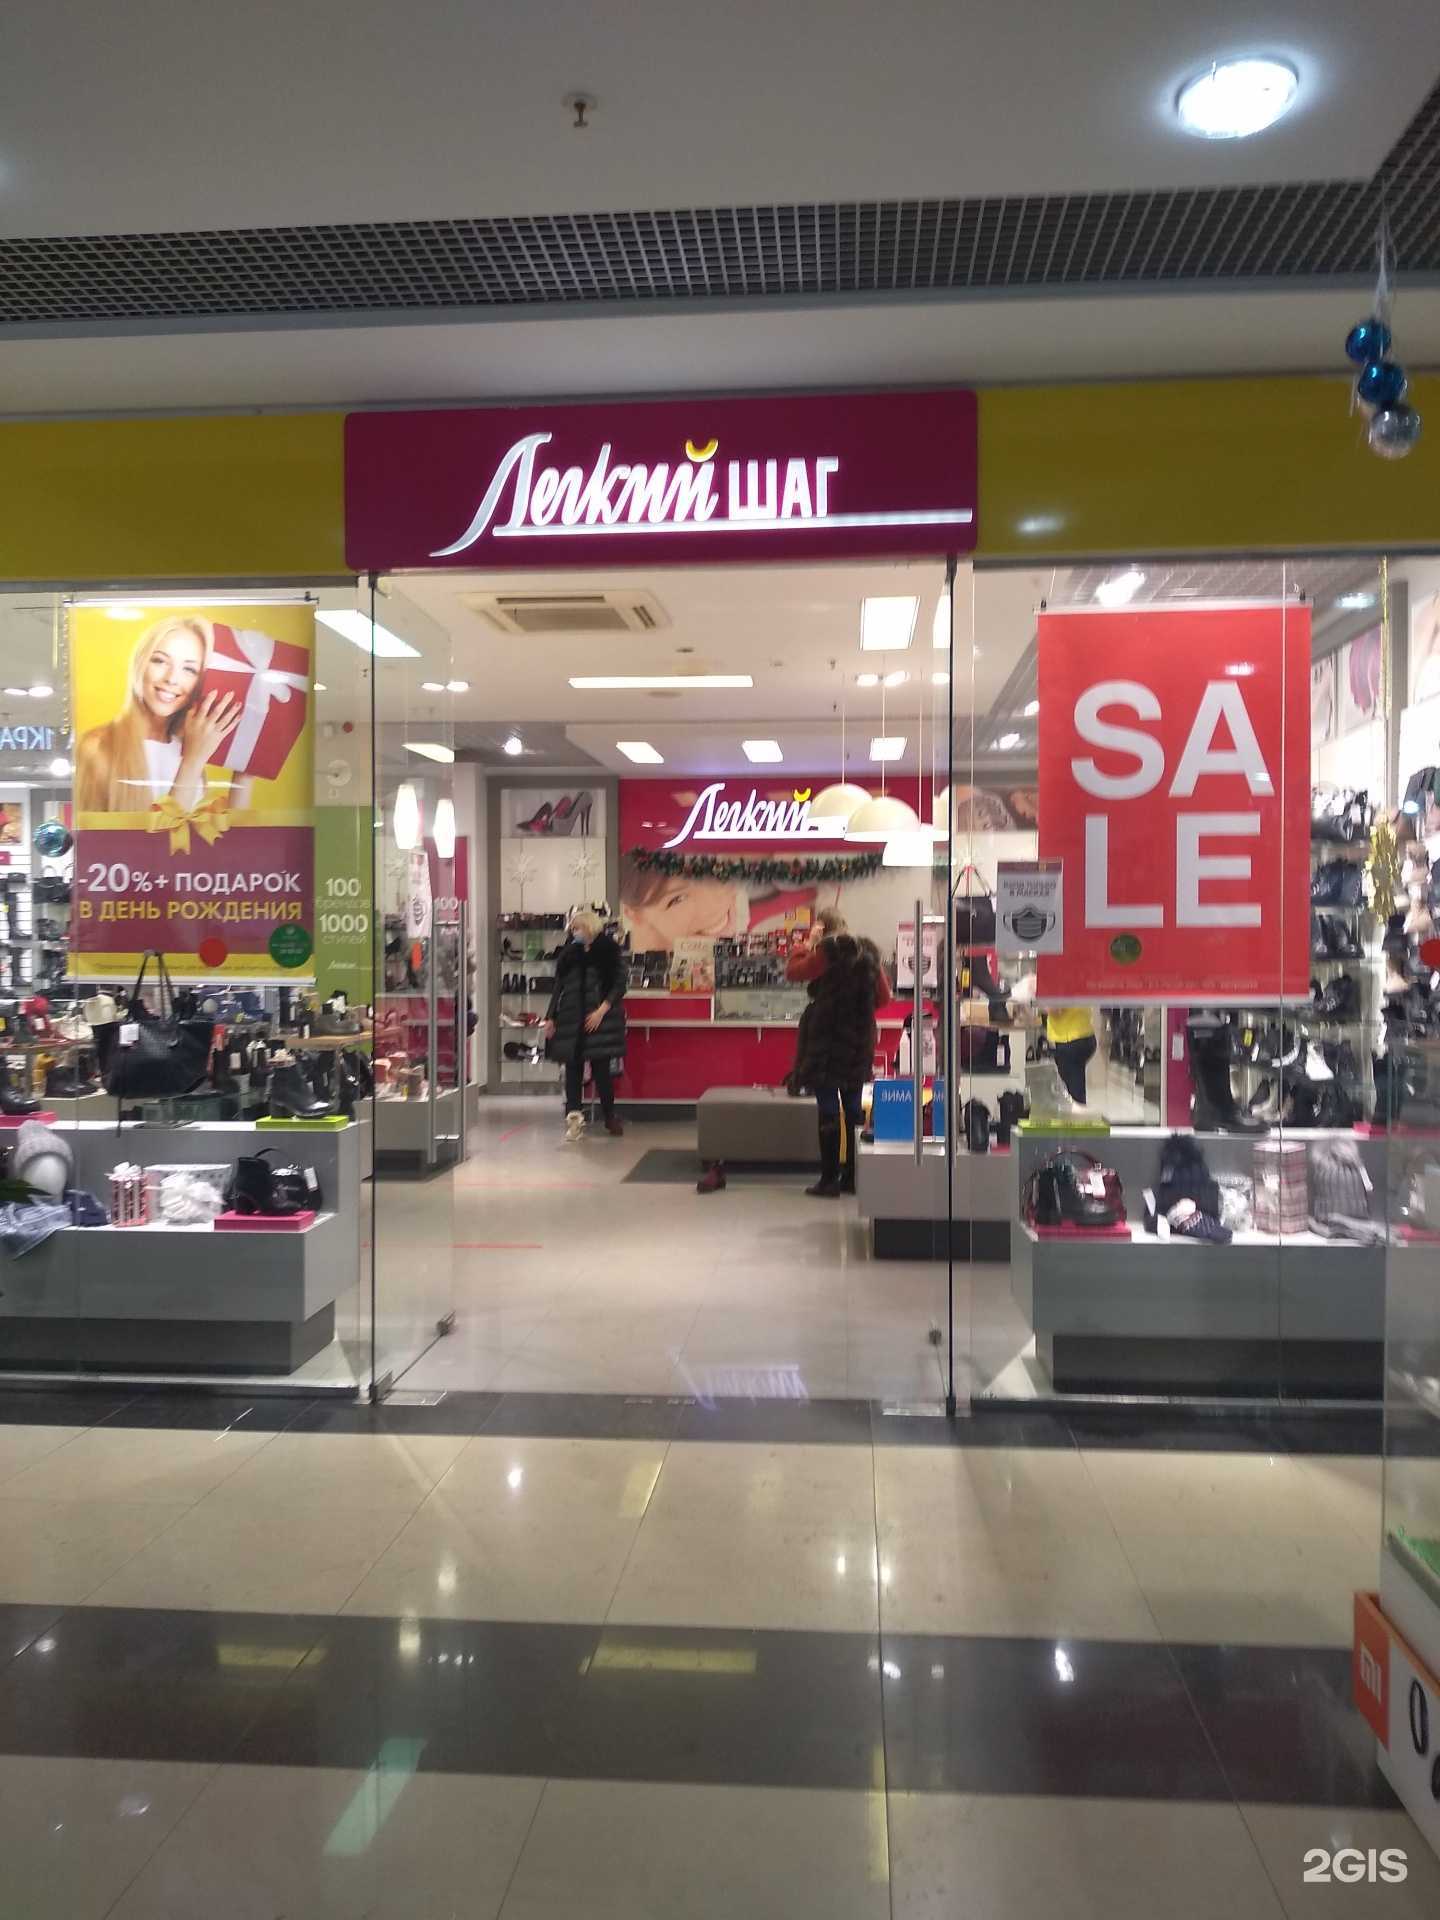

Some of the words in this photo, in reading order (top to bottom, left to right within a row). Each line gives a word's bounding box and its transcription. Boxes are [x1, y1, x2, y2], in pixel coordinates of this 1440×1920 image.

[429, 432, 719, 557] Легкий
[175, 871, 302, 895] ПОДАРОК
[326, 878, 361, 897] 100
[79, 901, 93, 919] В
[98, 901, 160, 922] ДЕНЬ
[167, 901, 302, 923] РОЖДЕНИЯ
[319, 914, 369, 933] 1000
